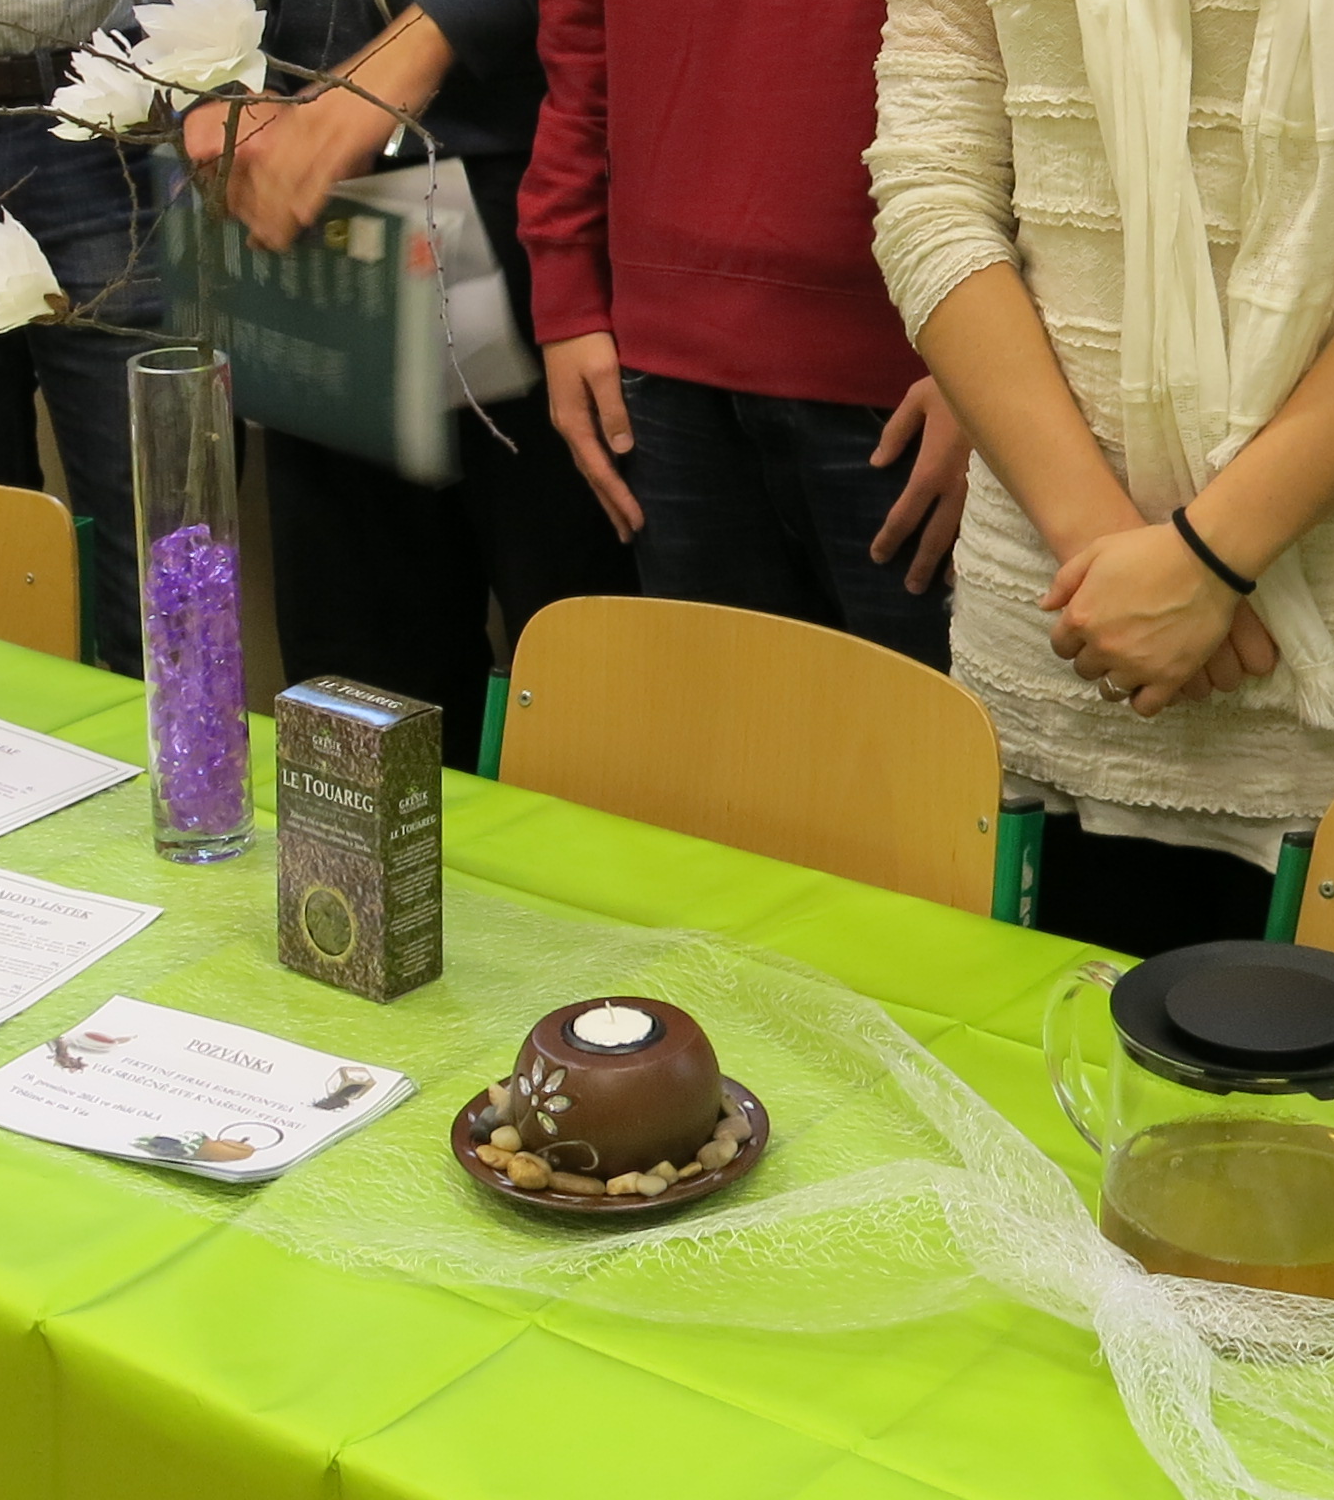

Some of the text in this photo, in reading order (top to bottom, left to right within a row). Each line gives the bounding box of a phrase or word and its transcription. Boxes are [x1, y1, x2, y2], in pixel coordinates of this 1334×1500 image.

[282, 768, 299, 790] LE
[302, 772, 374, 813] TOUAREG
[185, 1038, 274, 1074] POZVÁNKA
